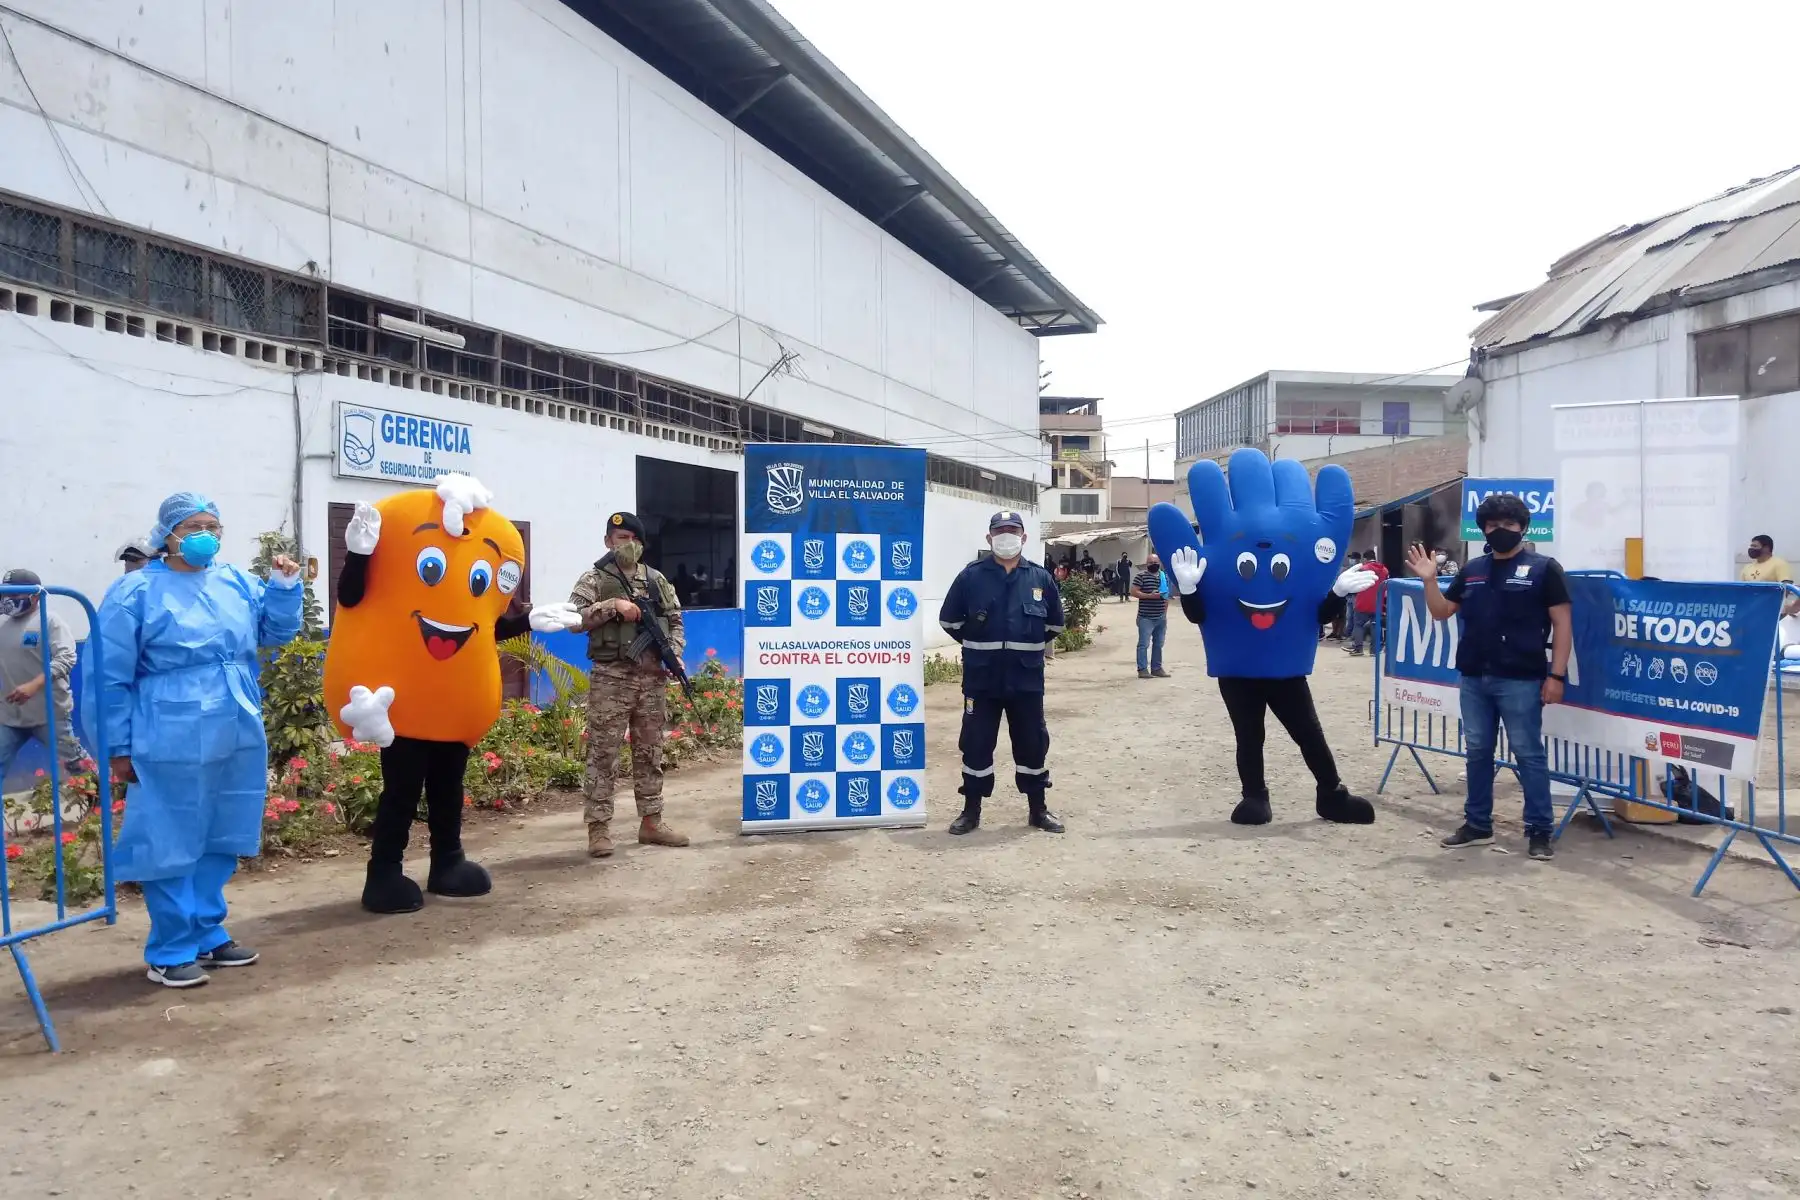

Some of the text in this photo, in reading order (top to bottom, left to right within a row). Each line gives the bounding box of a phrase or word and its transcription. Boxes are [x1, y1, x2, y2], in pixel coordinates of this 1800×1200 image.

[381, 413, 471, 455] GERENCIA
[424, 451, 432, 464] DE
[380, 461, 417, 478] SEGURIDAD
[808, 479, 904, 490] MUNICIPALIDAD DE
[808, 490, 904, 501] VILLA EL SALVADOR
[499, 568, 519, 583] MINSA
[1628, 599, 1674, 615] SALUD
[1675, 602, 1737, 618] DEPENDE
[1614, 613, 1732, 647] DE TODOS
[759, 639, 911, 650] VILLASALVADOREÑOS UNIDOS
[759, 652, 911, 665] CONTRA EL COVID-19
[1604, 688, 1740, 717] PROTÉGETE DE LA COVID-19
